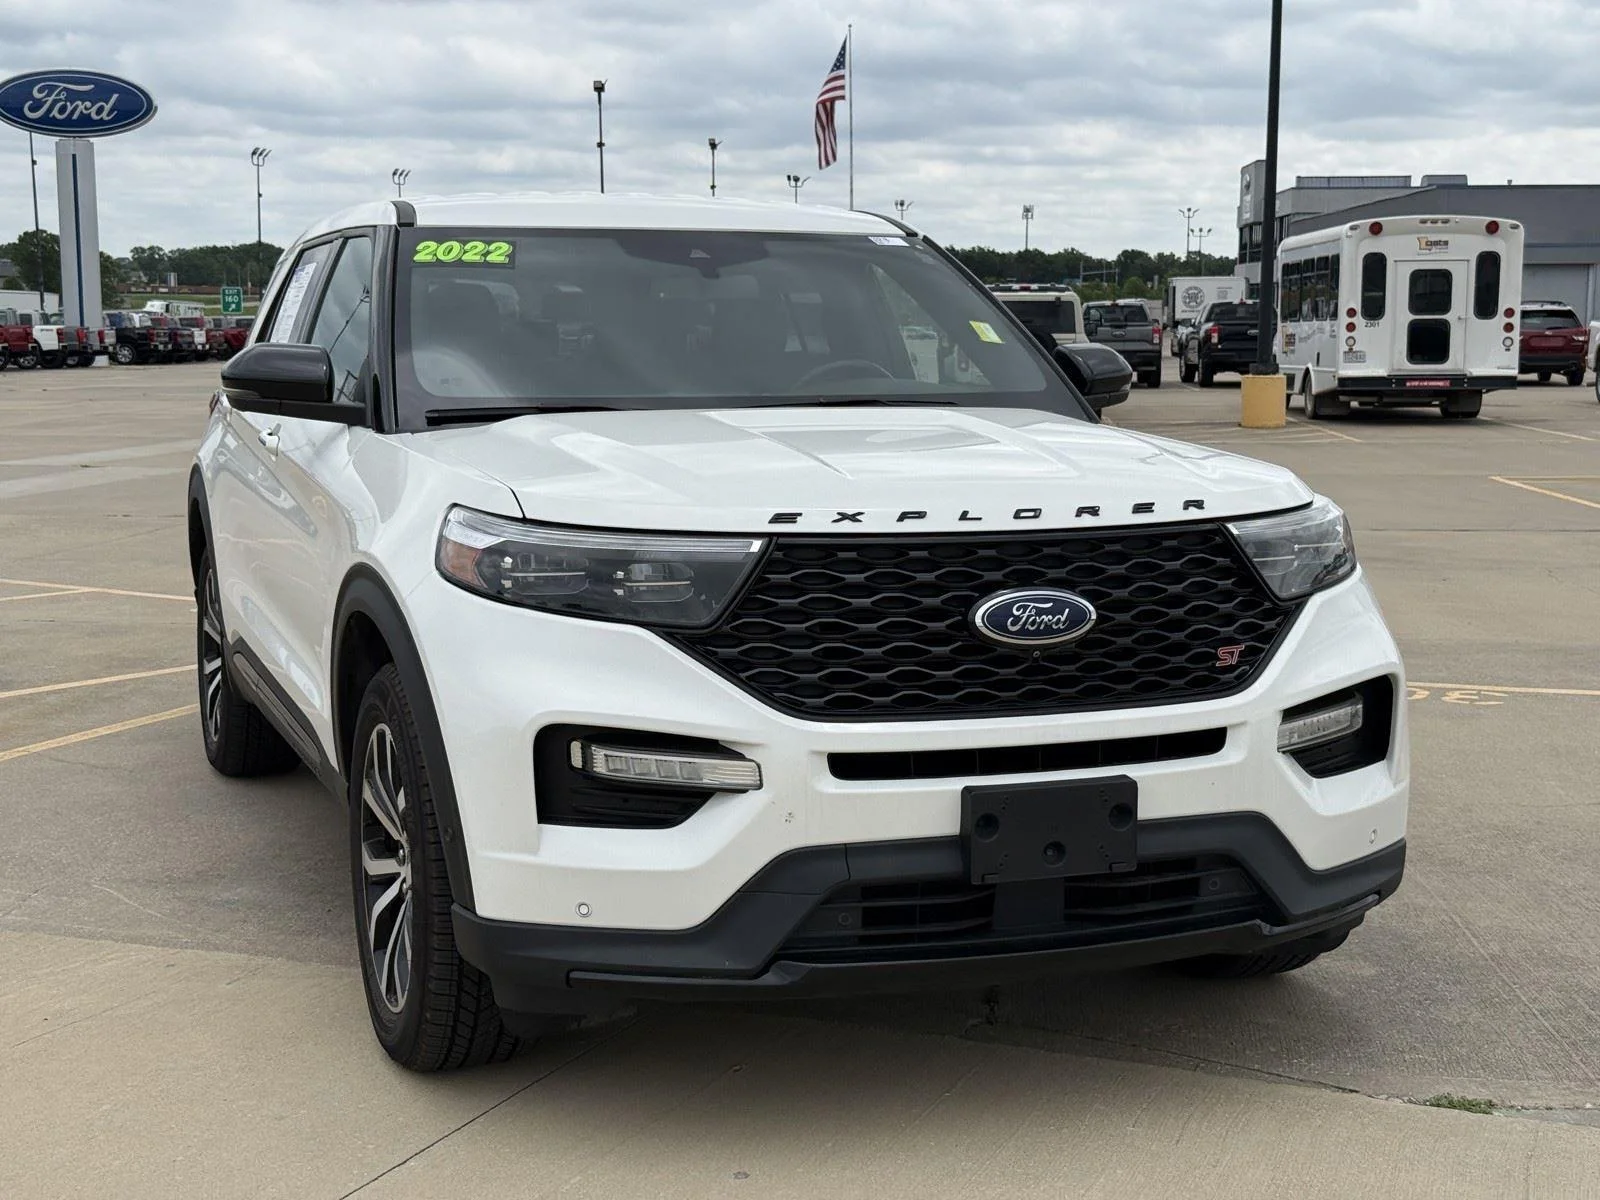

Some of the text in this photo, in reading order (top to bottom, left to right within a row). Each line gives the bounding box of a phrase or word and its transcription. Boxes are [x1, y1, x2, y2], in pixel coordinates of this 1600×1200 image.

[24, 81, 119, 121] Ford
[413, 240, 513, 263] 2022
[225, 295, 239, 303] 160
[768, 499, 1206, 525] EXPLORER
[1006, 602, 1070, 632] Ford
[1215, 644, 1246, 668] ST
